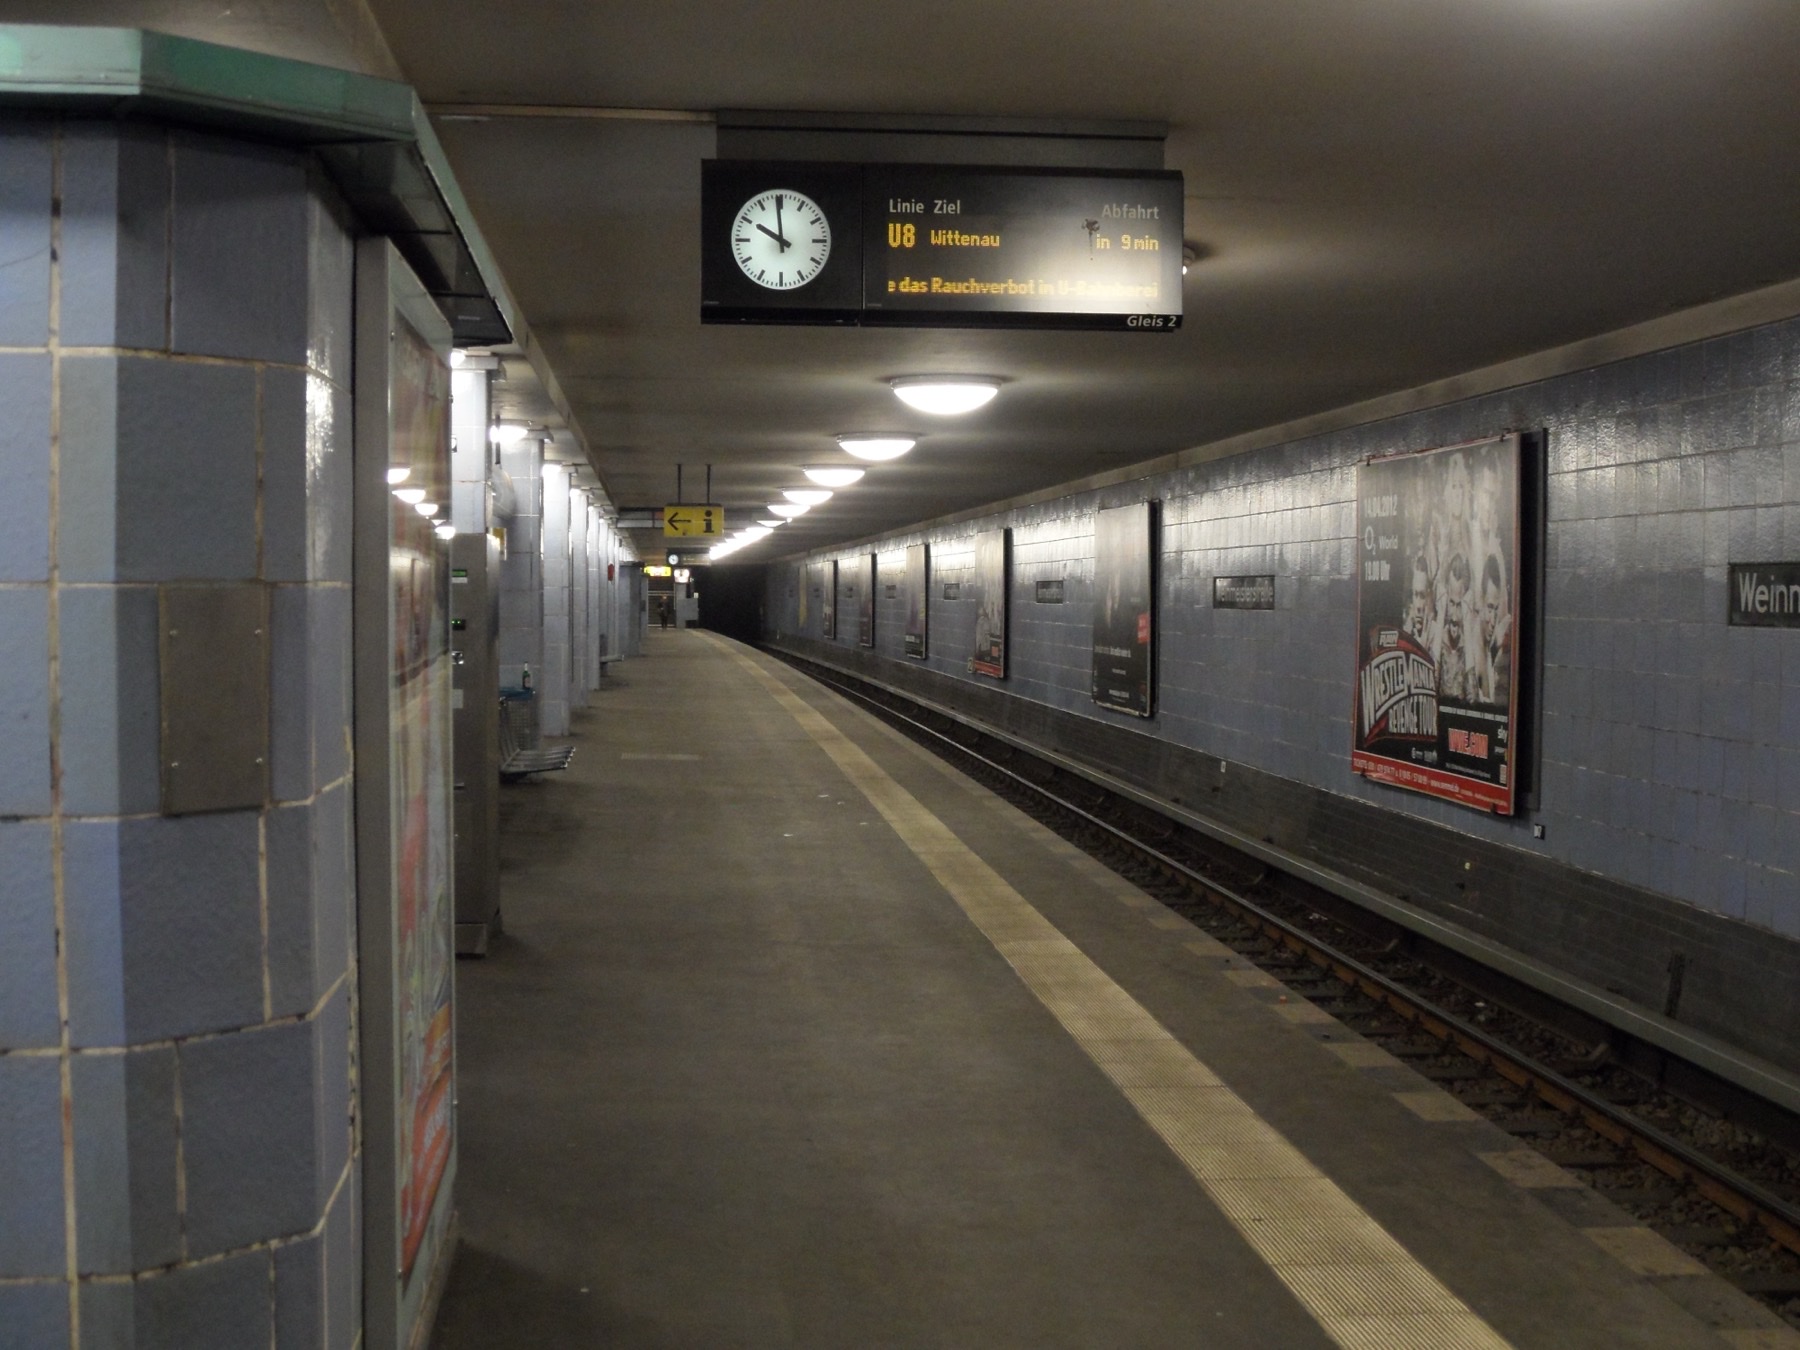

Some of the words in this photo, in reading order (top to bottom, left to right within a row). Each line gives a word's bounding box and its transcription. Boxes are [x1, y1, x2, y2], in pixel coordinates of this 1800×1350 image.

[888, 199, 924, 214] Linie
[933, 200, 961, 215] Ziel
[1101, 204, 1159, 220] Abfahrt
[888, 223, 916, 248] U8
[930, 229, 1000, 247] Wittenau
[1096, 234, 1111, 249] in
[899, 276, 928, 293] das
[1127, 315, 1163, 327] Gleis
[1167, 315, 1177, 327] 2
